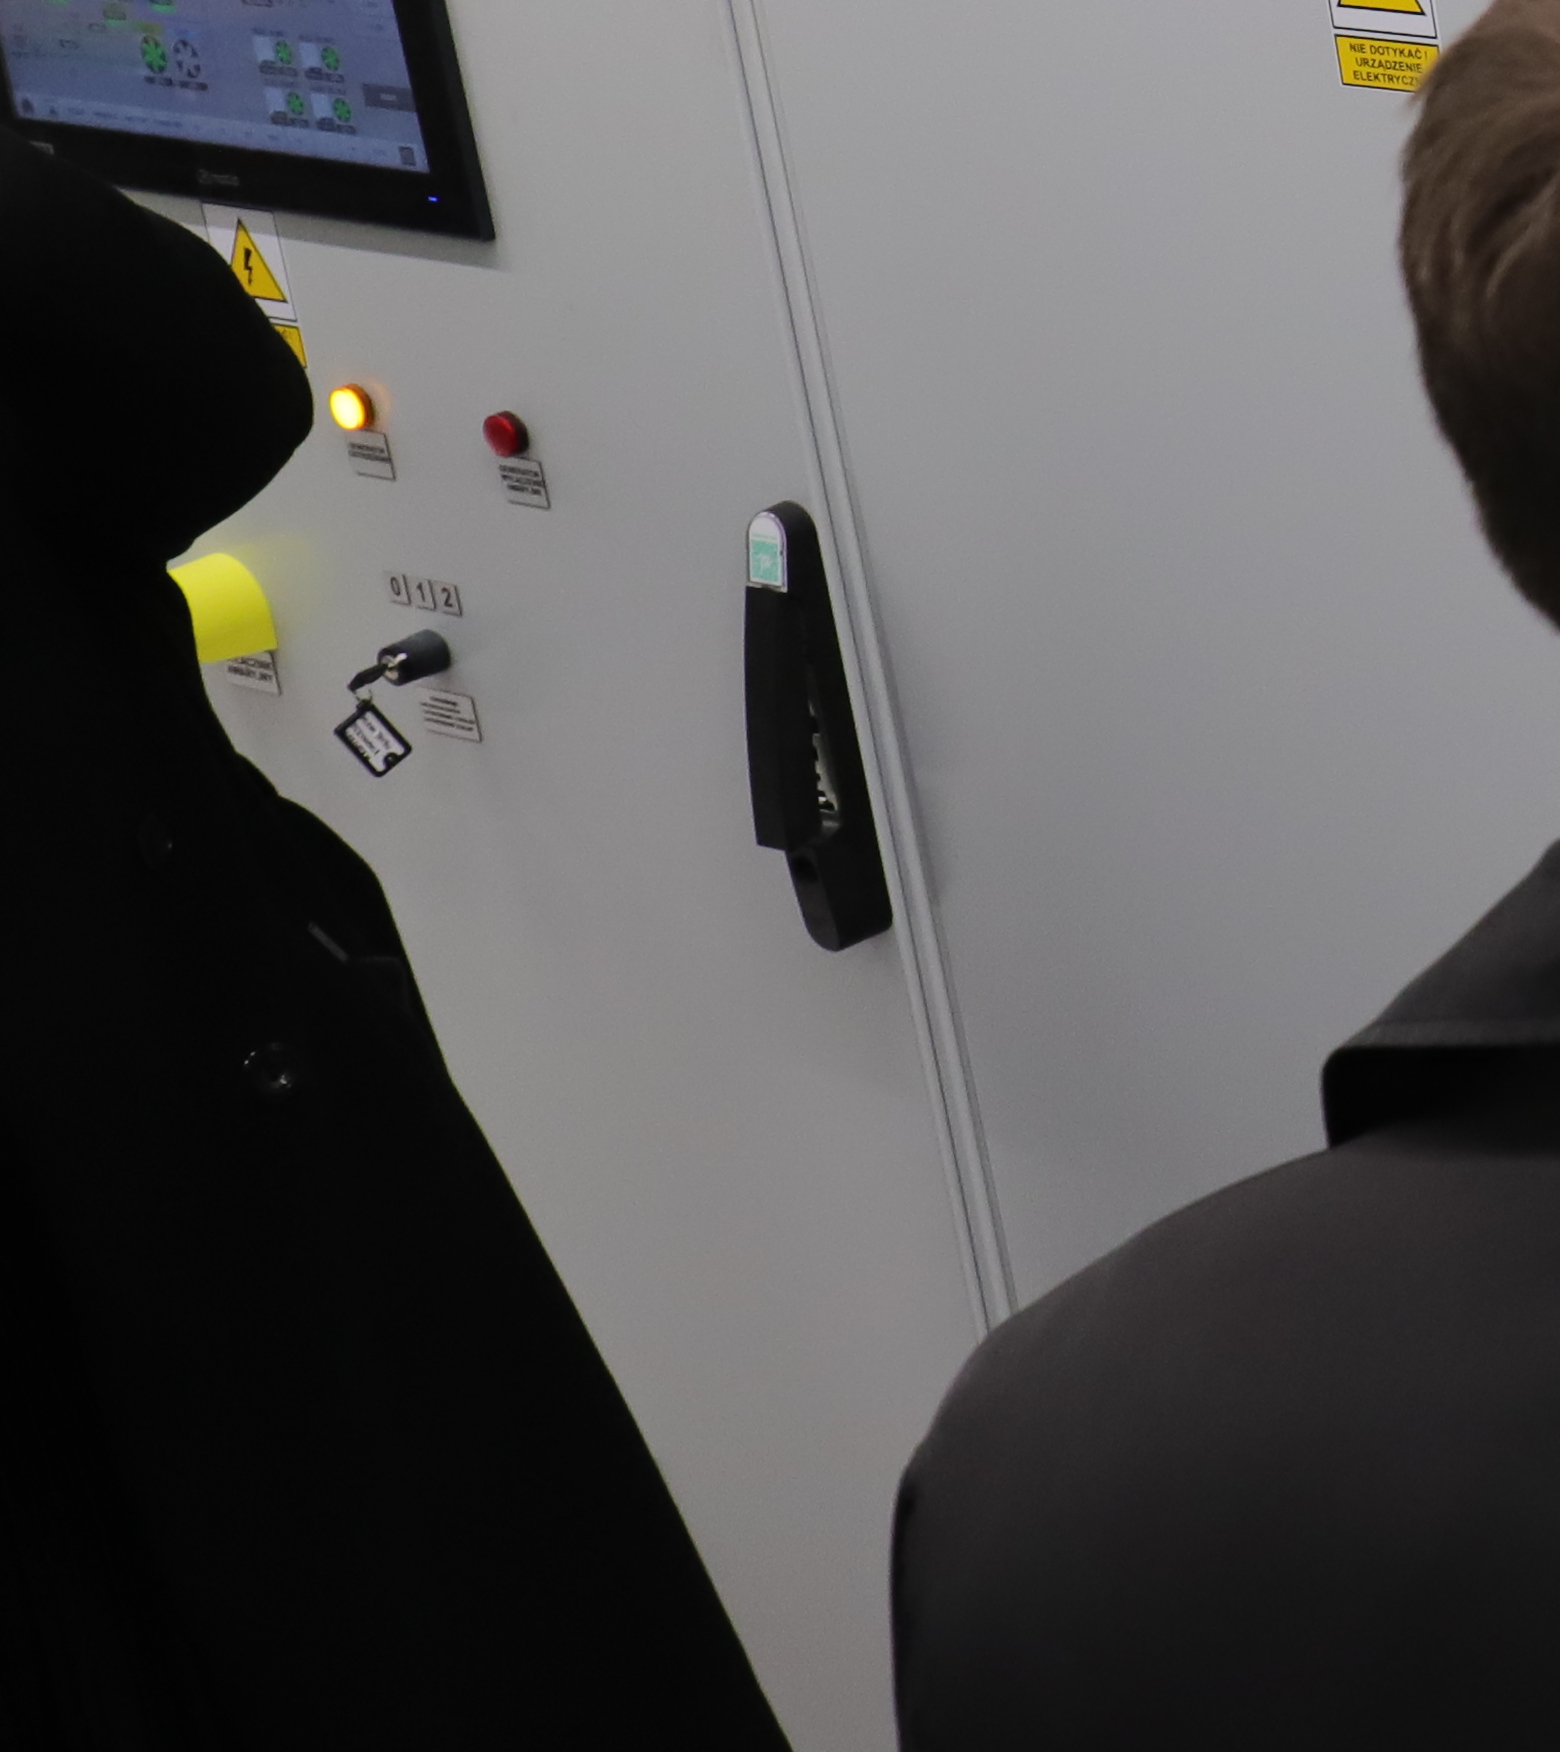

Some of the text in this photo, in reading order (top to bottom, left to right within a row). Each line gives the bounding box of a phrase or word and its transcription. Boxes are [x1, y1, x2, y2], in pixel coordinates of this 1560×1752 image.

[1350, 43, 1365, 53] NIE
[1370, 45, 1422, 59] DOTYKAĆ
[1355, 58, 1422, 73] URZĄDZENIE
[1353, 70, 1419, 86] ELEKTRYCZ
[390, 577, 452, 607] 0 1 2
